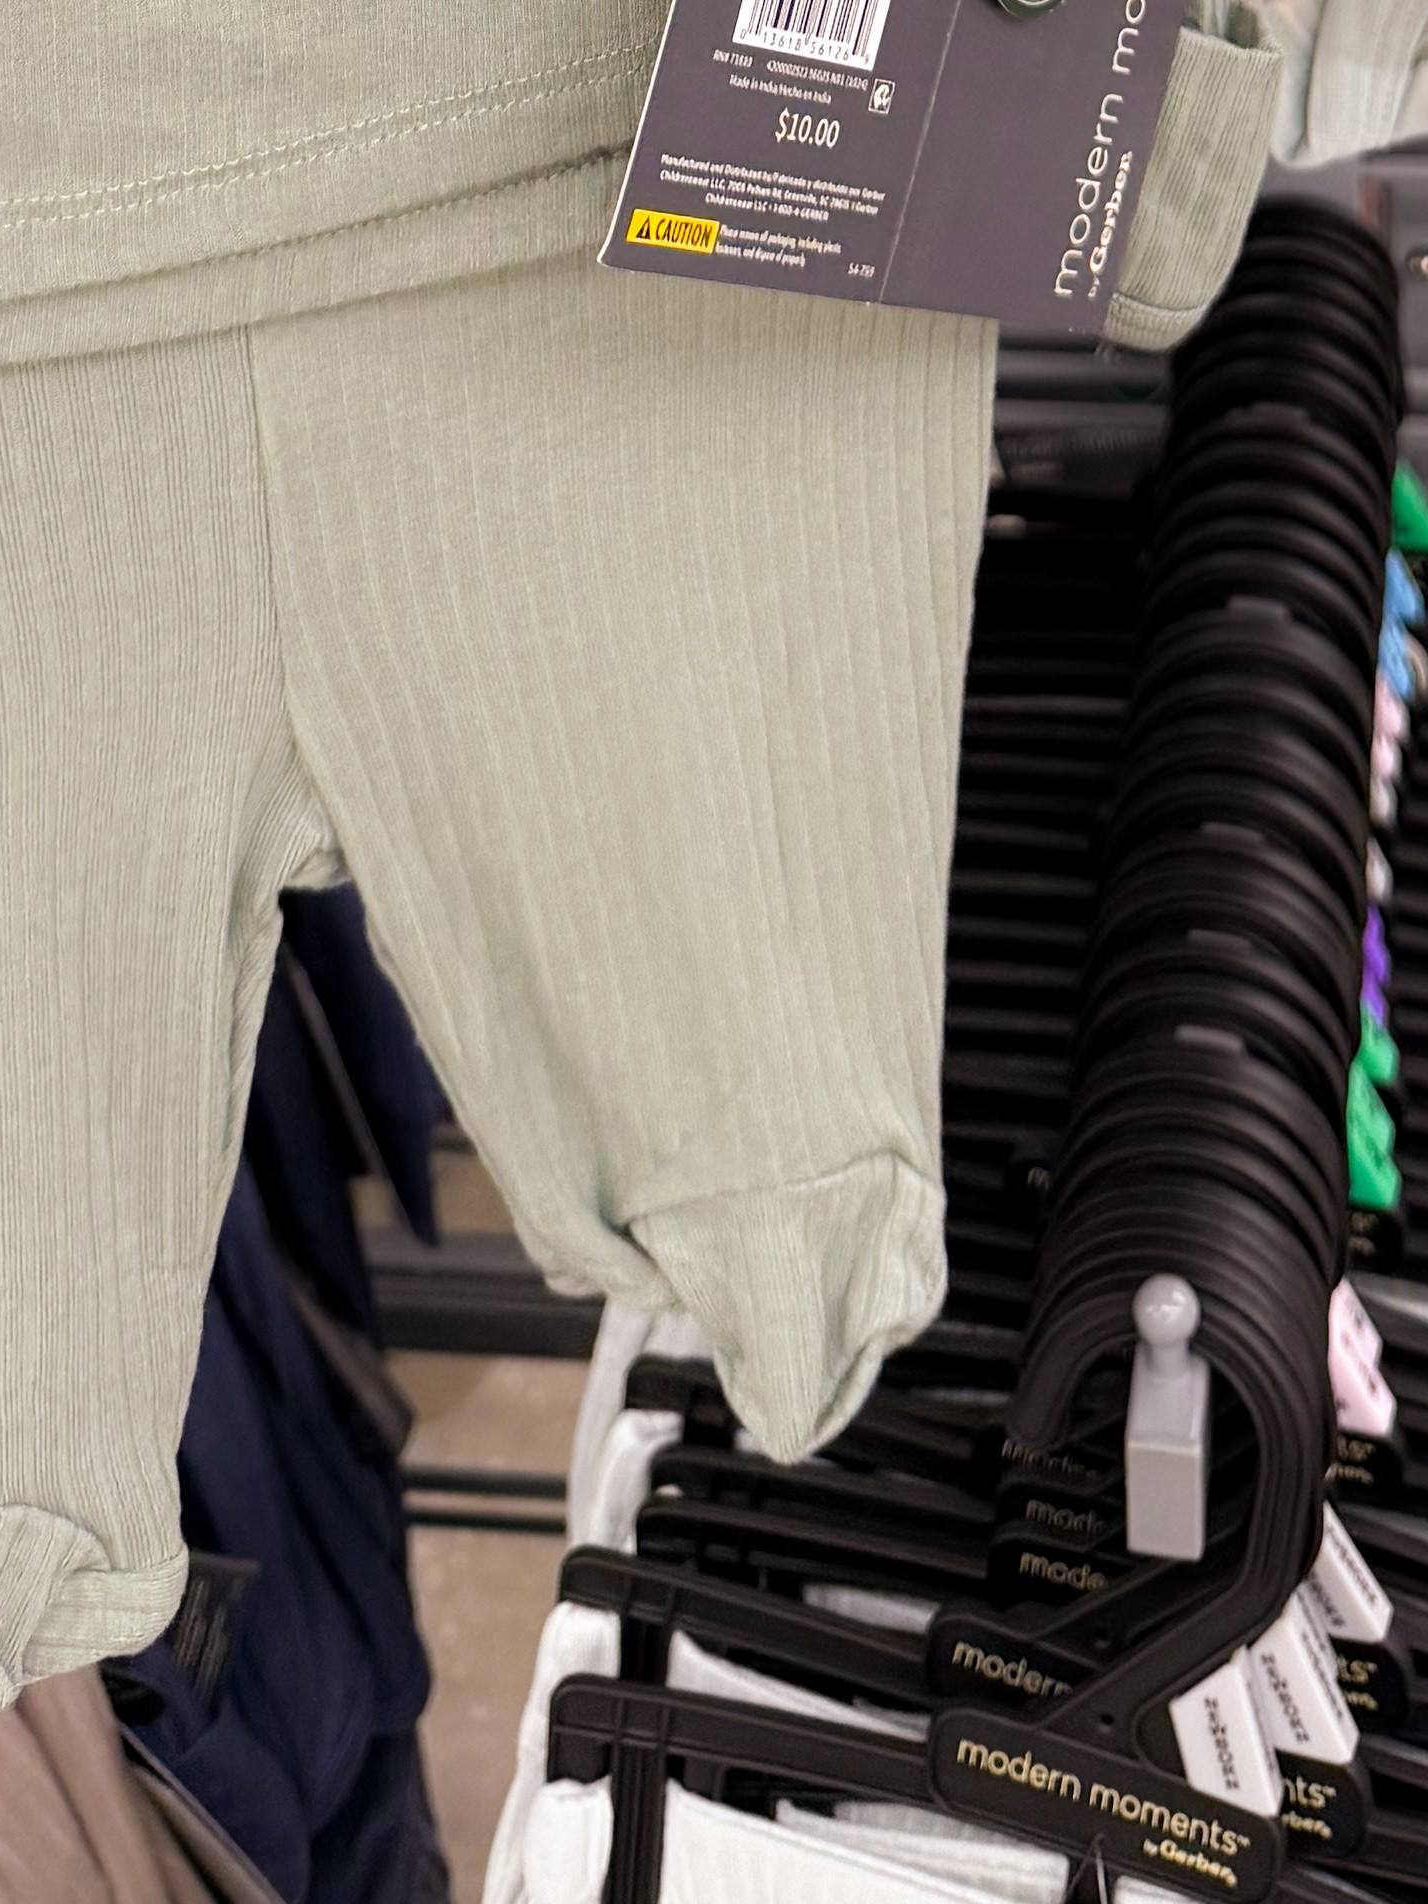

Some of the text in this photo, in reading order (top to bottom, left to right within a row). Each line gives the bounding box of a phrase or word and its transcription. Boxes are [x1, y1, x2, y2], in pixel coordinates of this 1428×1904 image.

[774, 109, 842, 150] $10.00
[1053, 92, 1123, 299] modern
[652, 215, 713, 249] CAUTION
[956, 1737, 1082, 1802] modern
